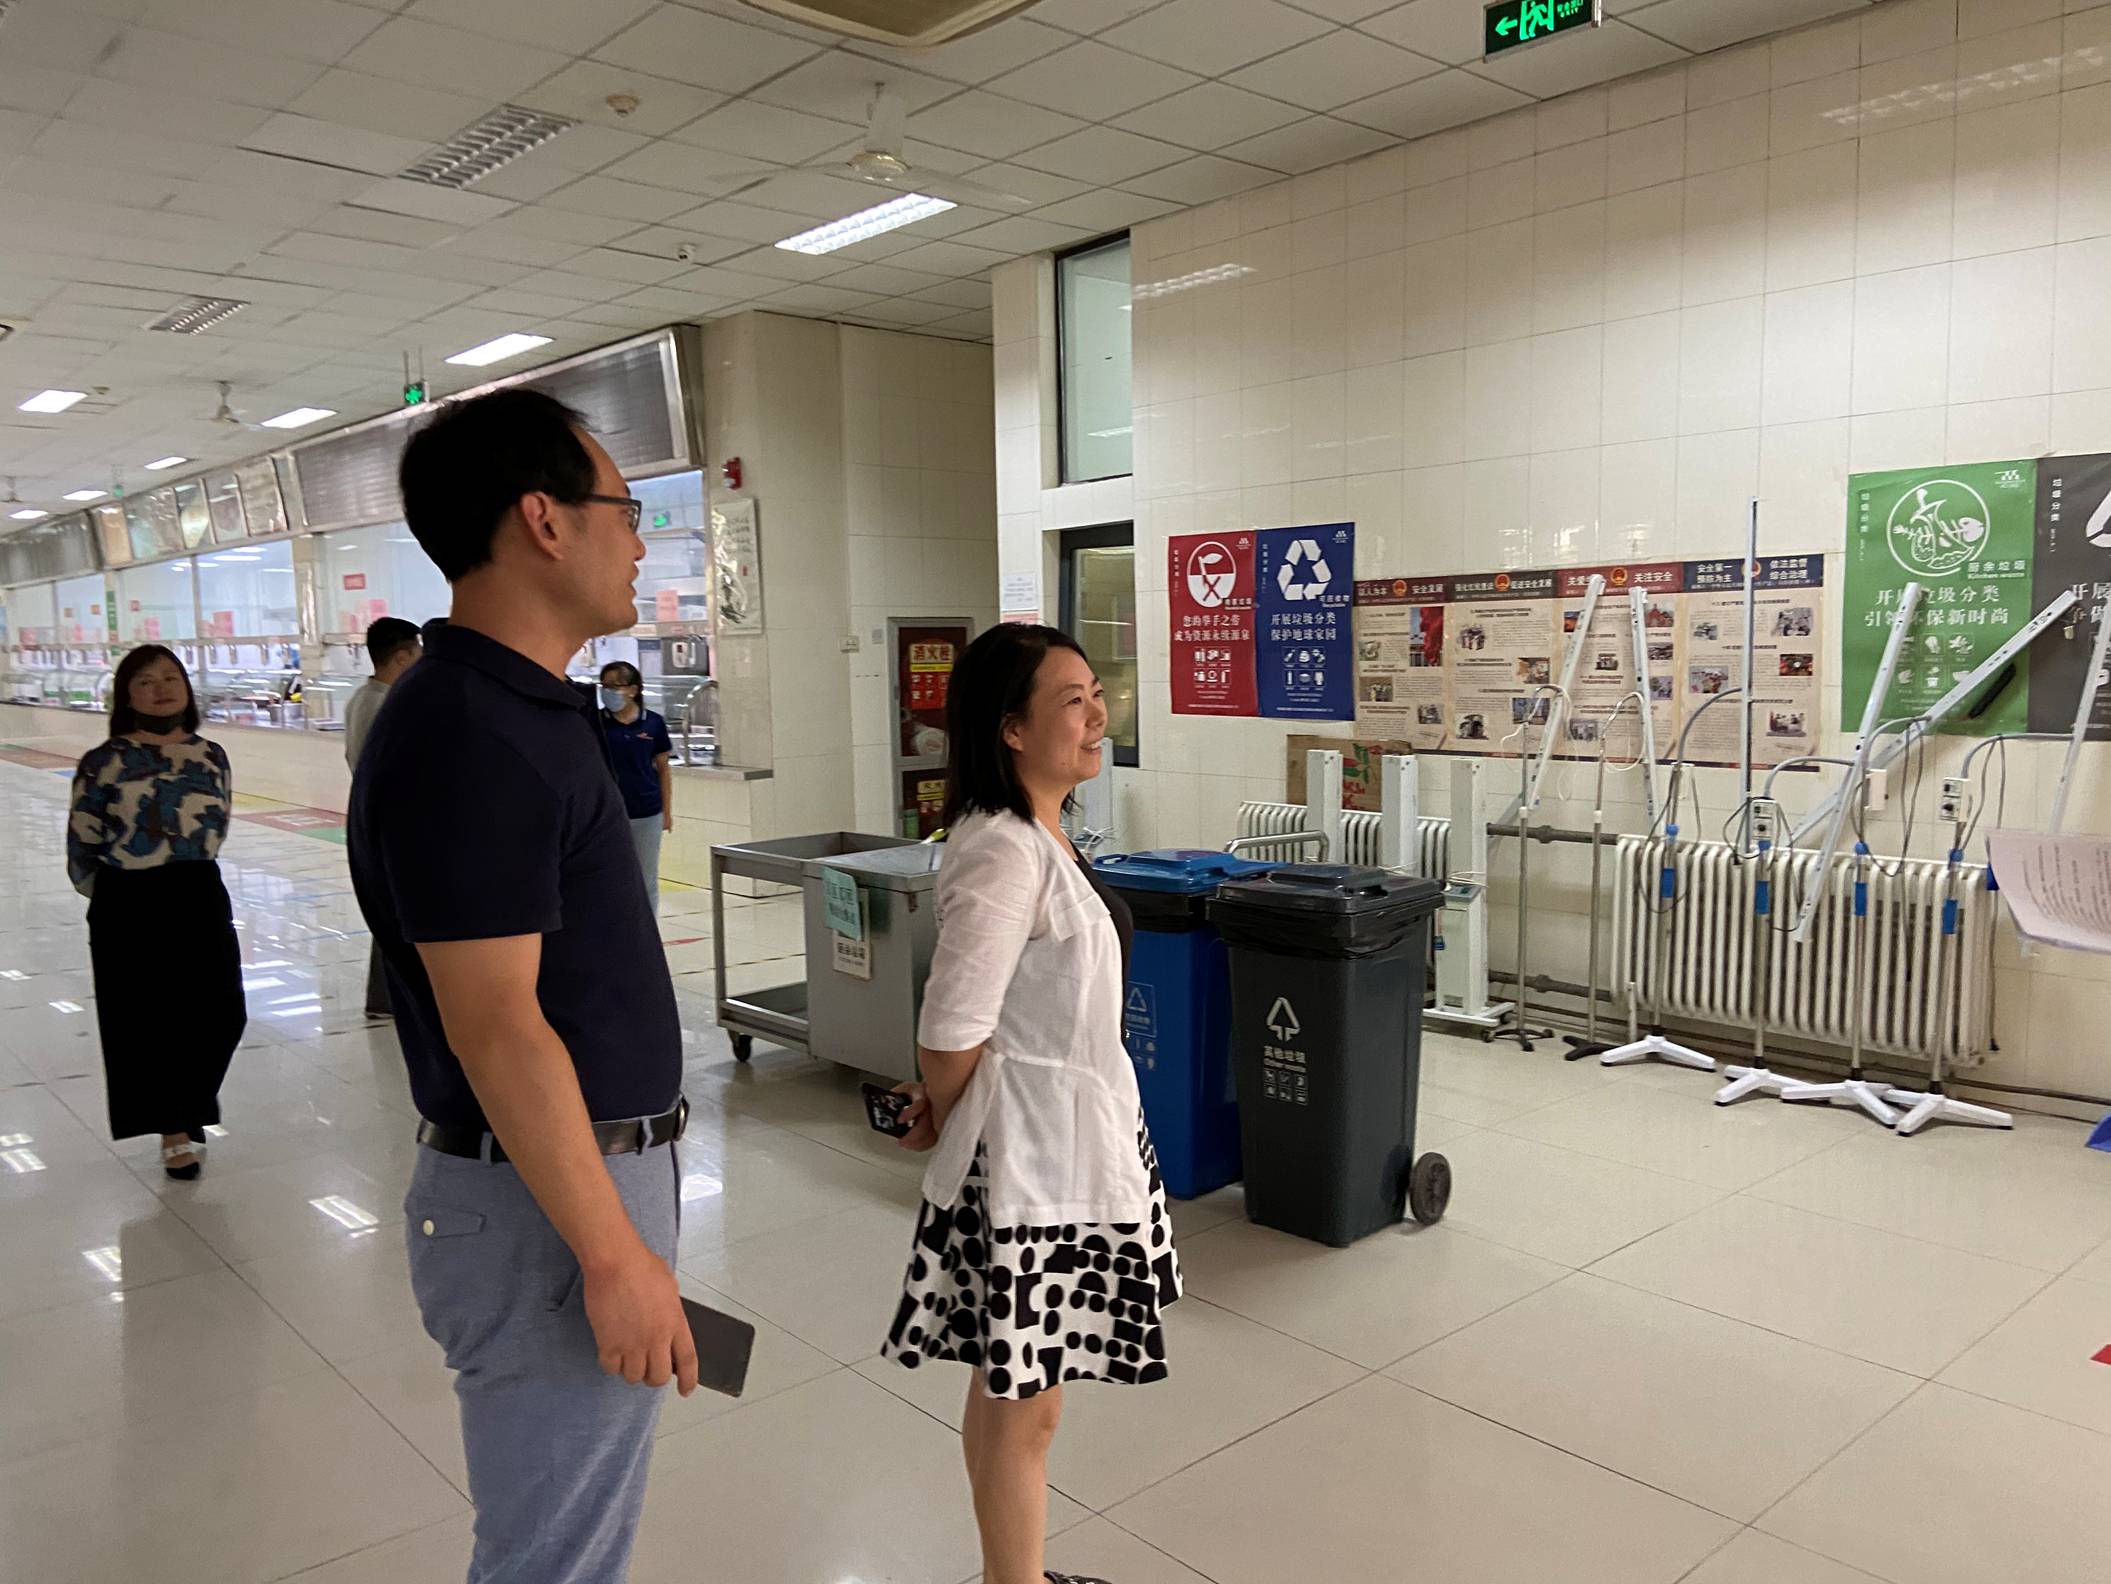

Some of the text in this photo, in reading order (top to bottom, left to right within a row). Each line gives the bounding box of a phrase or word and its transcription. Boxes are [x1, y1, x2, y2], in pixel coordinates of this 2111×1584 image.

[1697, 563, 1734, 573] 安全第一
[1634, 571, 1673, 583] 关注安全
[1696, 574, 1732, 584] 预防为主
[1768, 569, 1808, 580] 综合治理
[1412, 584, 1444, 595] 安全发展
[1271, 612, 1336, 626] 开展垃圾分类
[1271, 628, 1337, 641] 保护地球家园
